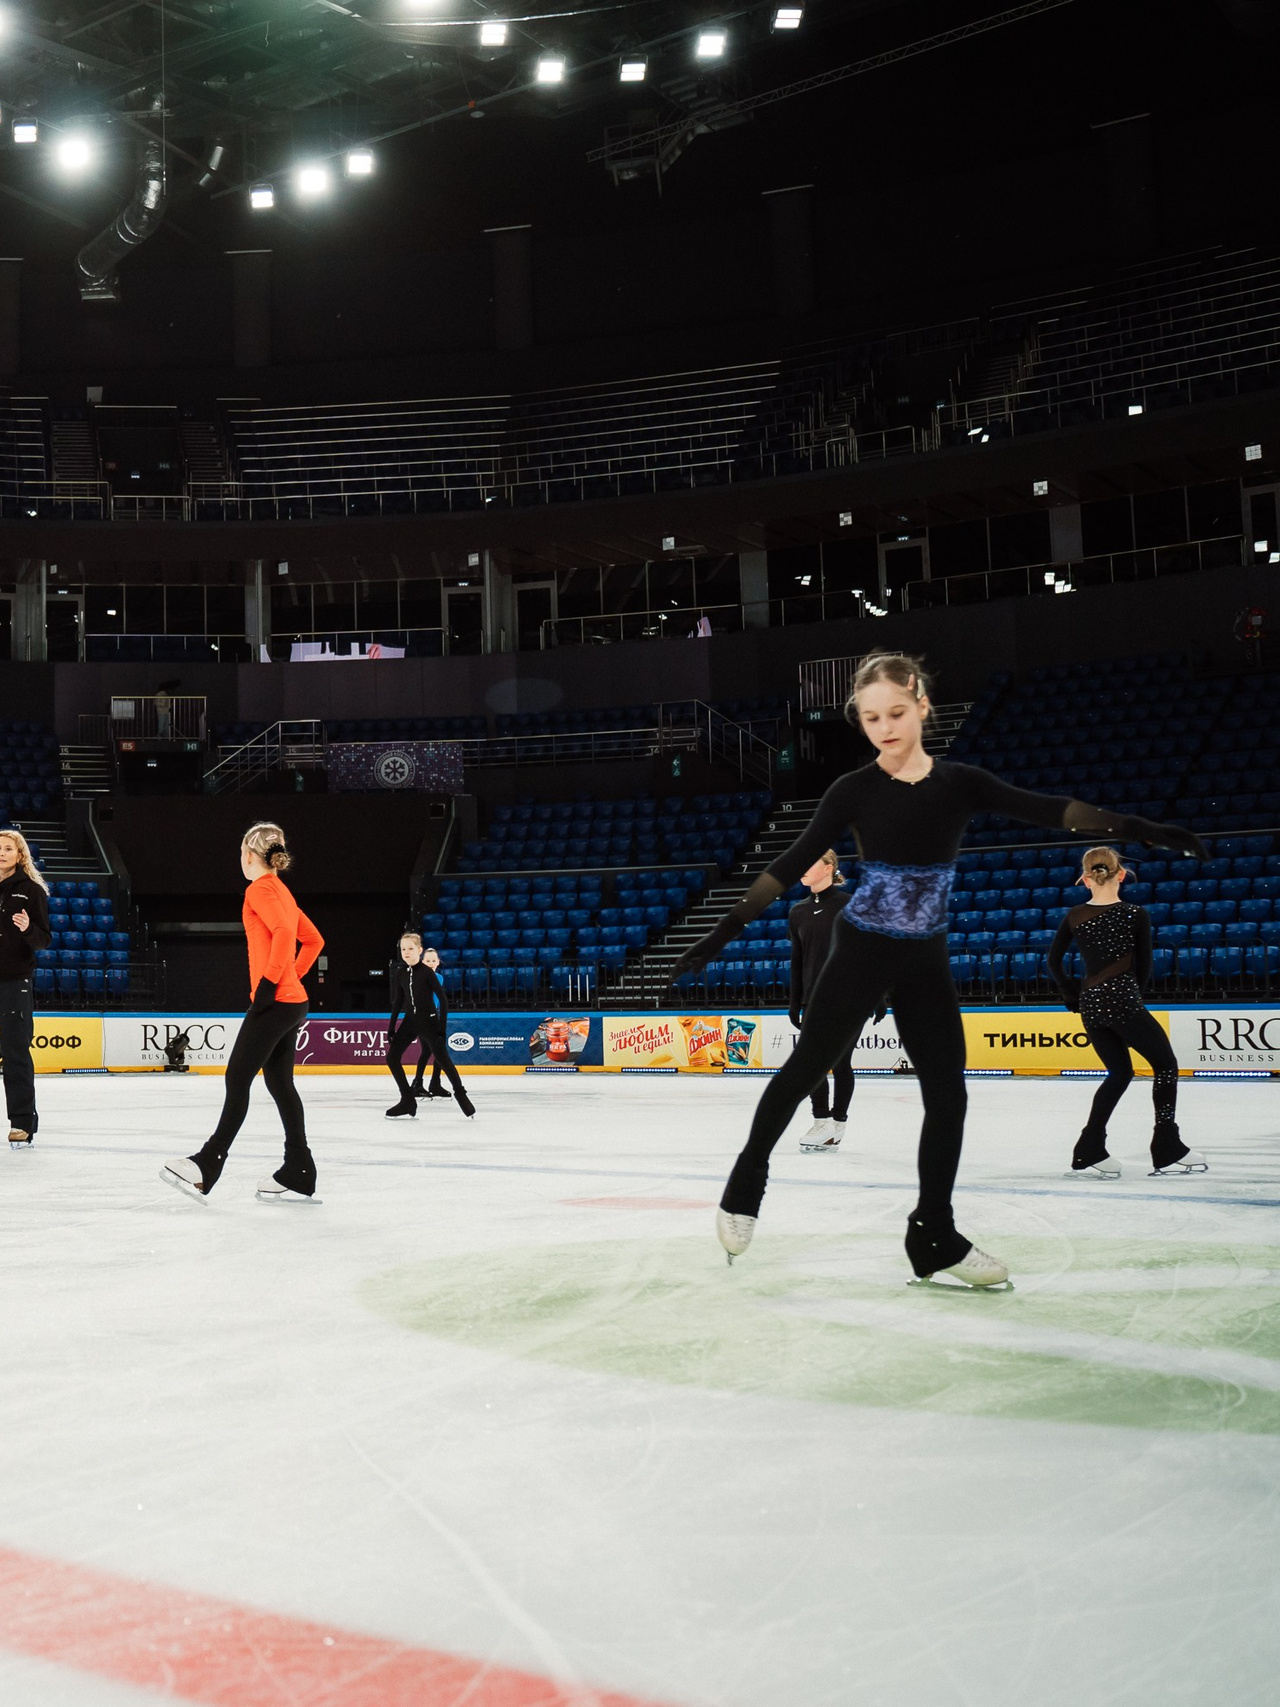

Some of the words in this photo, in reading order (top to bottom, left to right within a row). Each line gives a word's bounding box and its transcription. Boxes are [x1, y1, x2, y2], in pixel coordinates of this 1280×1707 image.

[810, 712, 821, 720] H1
[782, 804, 792, 812] 10
[609, 1027, 637, 1041] Знаем
[612, 1024, 670, 1052] любим
[983, 1033, 1092, 1048] ТИНЬКО
[1196, 1018, 1280, 1050] RRC
[354, 1049, 386, 1057] магаз
